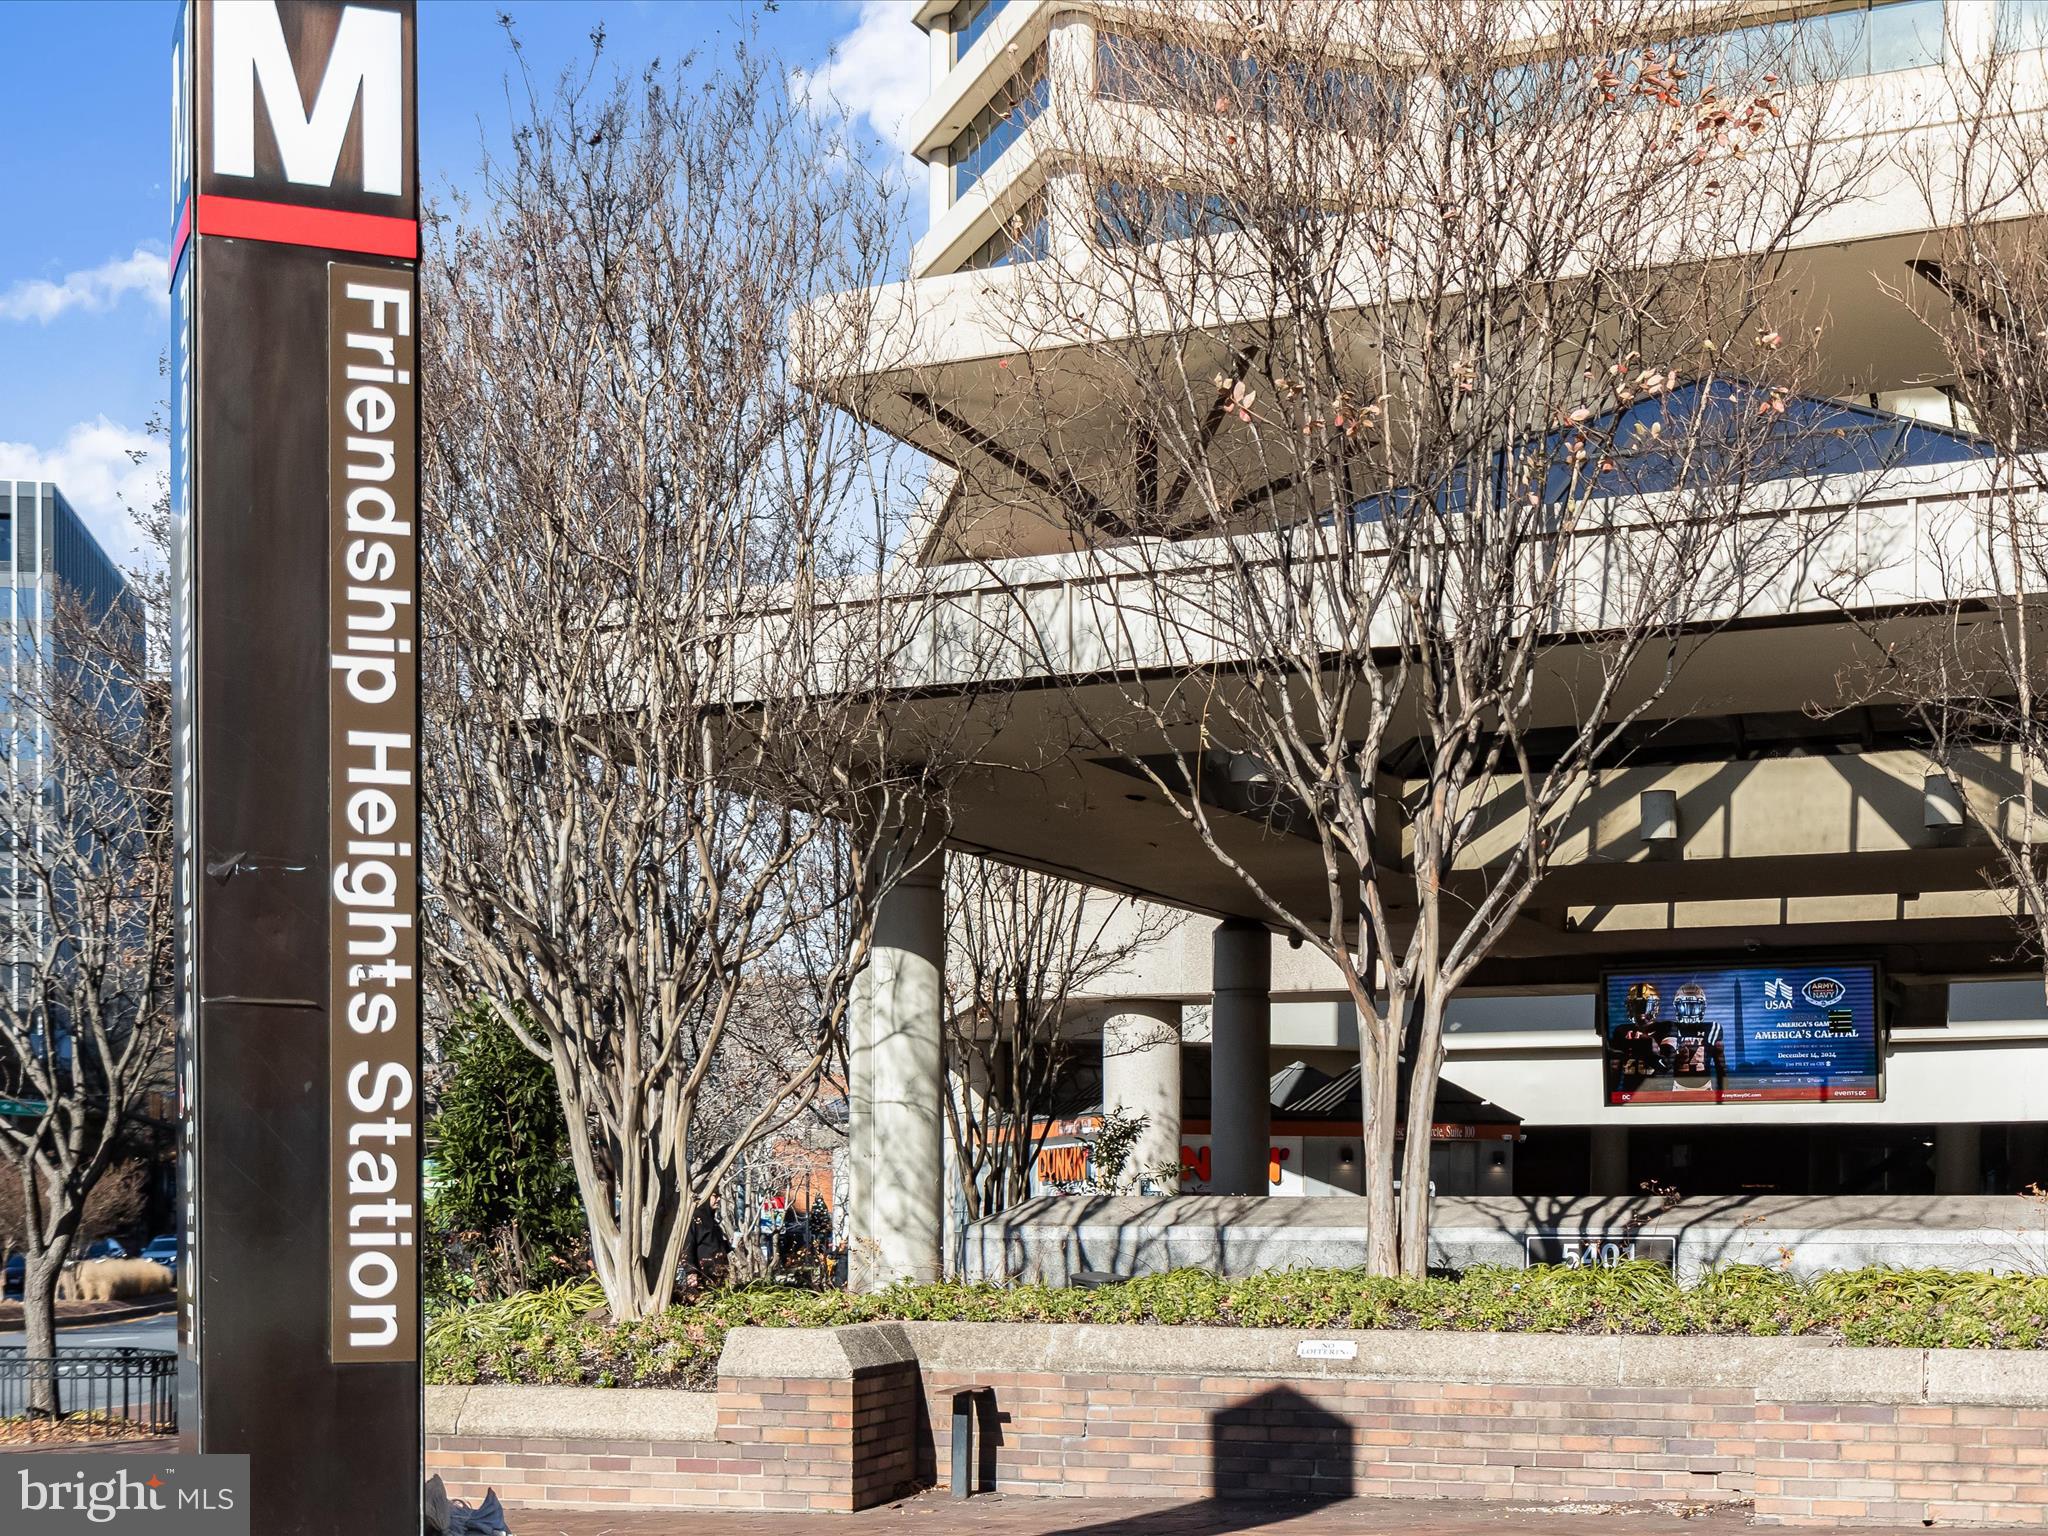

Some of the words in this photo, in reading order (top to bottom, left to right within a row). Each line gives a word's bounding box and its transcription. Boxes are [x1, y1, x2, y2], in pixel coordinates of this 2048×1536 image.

[212, 0, 403, 197] M
[330, 282, 413, 705] Friendship
[333, 730, 413, 1035] Heights
[1812, 982, 1835, 991] ARMY
[1812, 991, 1835, 999] NAVY
[1765, 1000, 1793, 1010] USAA
[1754, 1029, 1812, 1040] AMERICA'S
[1446, 1125, 1463, 1138] Suite
[347, 1061, 414, 1348] Station
